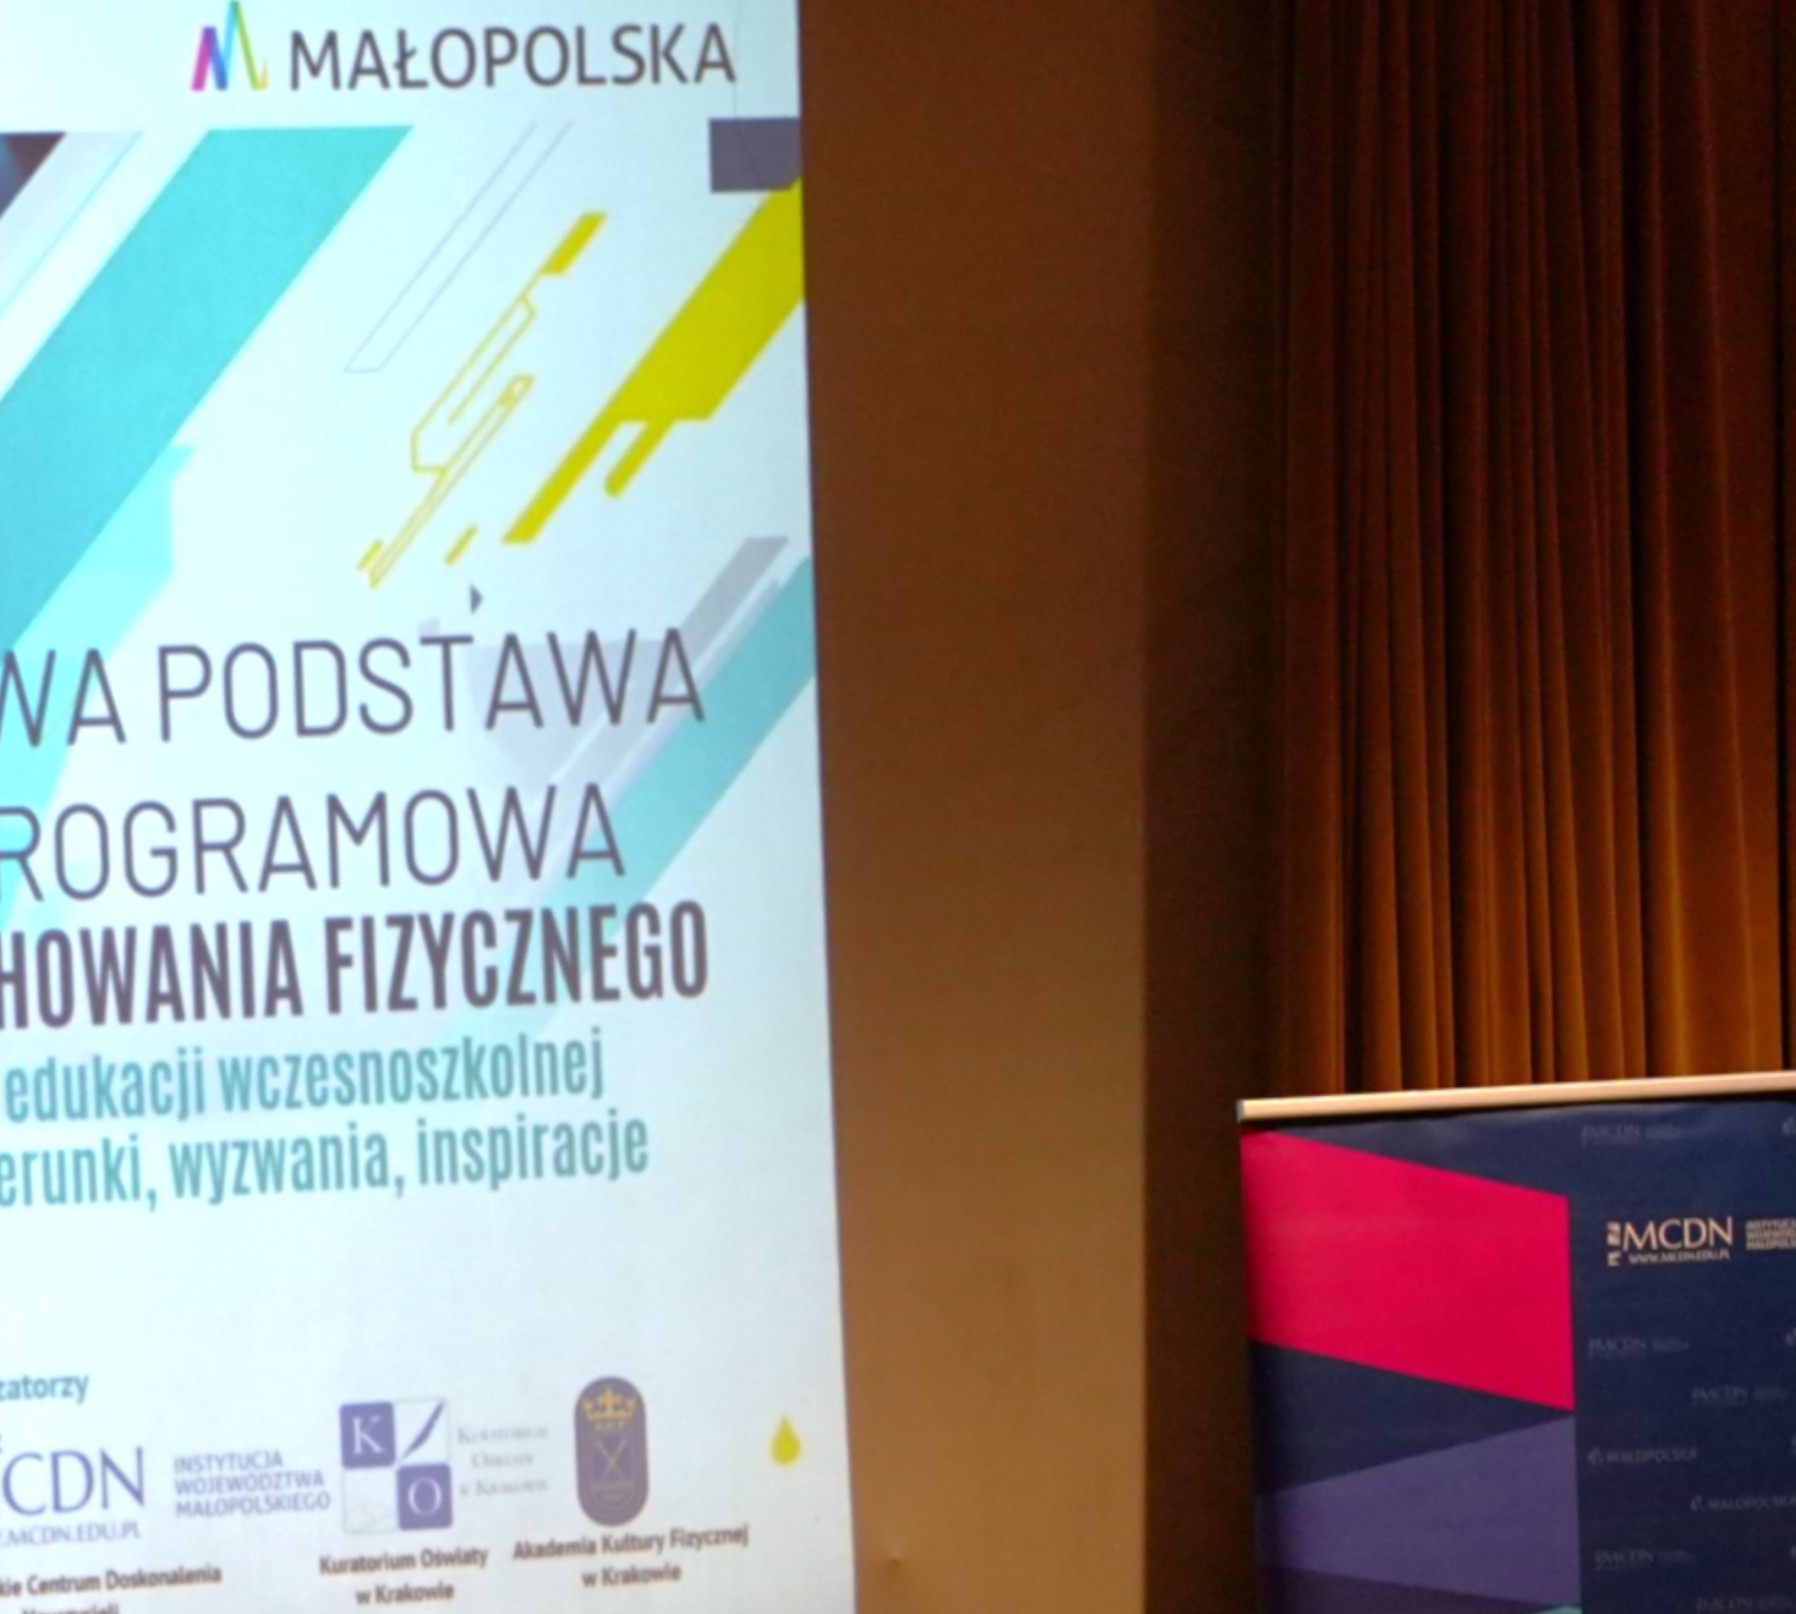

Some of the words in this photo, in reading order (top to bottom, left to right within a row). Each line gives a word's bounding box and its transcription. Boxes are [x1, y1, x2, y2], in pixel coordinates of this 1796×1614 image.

[289, 23, 737, 91] MAŁOPOLSKA
[157, 627, 706, 744] PODSTAWA
[324, 900, 709, 1016] FIZYCZNEGO
[8, 1047, 206, 1122] edukacji
[218, 1027, 605, 1113] wczesnoszkolnej
[170, 1122, 405, 1202] wyzwania,
[416, 1108, 650, 1192] inspiracje
[1622, 1216, 1734, 1252] MCDN
[352, 1416, 384, 1456] K
[173, 1451, 284, 1474] INSTYTUCJA
[174, 1470, 326, 1496] WOJEWÓDZTWA
[408, 1475, 442, 1516] O
[175, 1492, 332, 1519] MAŁOPOLSKIEGO
[319, 1552, 416, 1575] Kuratorium
[421, 1545, 489, 1573] Oświaty
[513, 1538, 598, 1561] Akademia
[601, 1532, 665, 1559] Kultury
[670, 1524, 750, 1550] Fizycznej
[27, 1572, 102, 1597] Centrum
[106, 1565, 223, 1592] Doskonalenia
[355, 1589, 372, 1606] w
[376, 1581, 455, 1605] Krakowie
[581, 1572, 597, 1588] w
[602, 1563, 683, 1586] Krakowie
